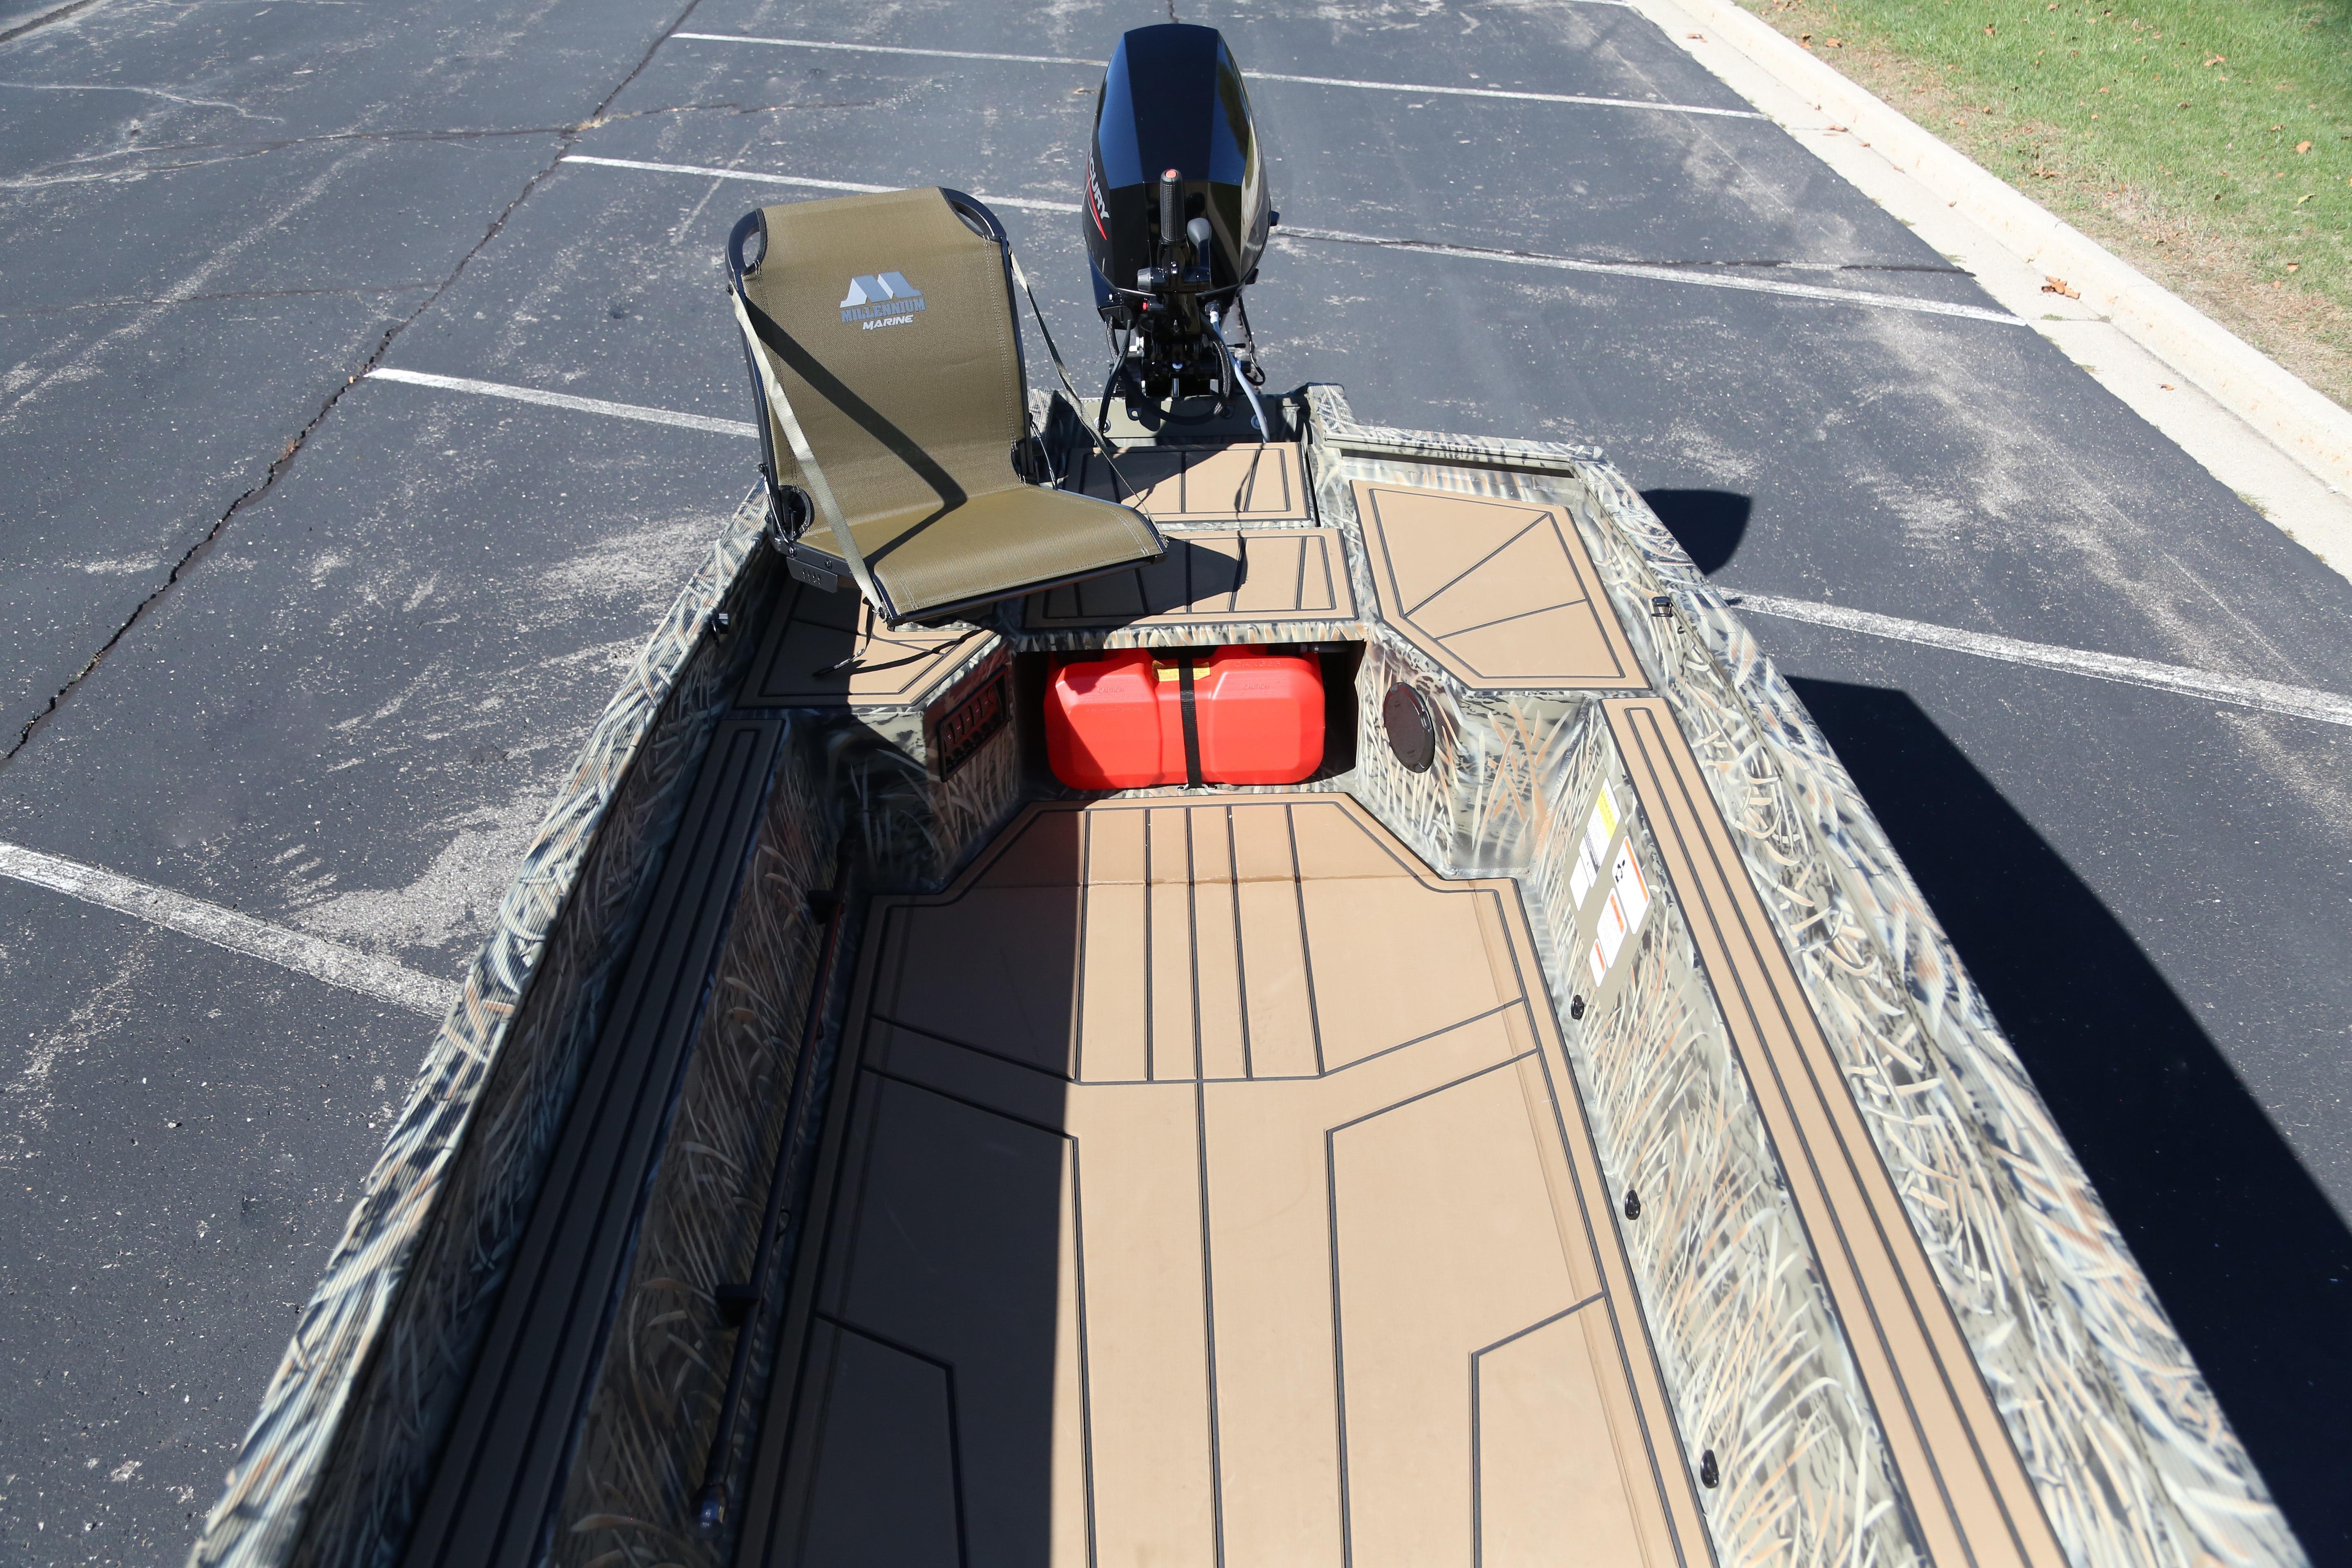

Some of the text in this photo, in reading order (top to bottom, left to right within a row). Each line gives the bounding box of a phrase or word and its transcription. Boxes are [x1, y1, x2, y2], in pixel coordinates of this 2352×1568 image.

[1088, 140, 1110, 219] RCURY
[840, 298, 927, 323] MILLENNIUM
[862, 314, 914, 330] MARINE
